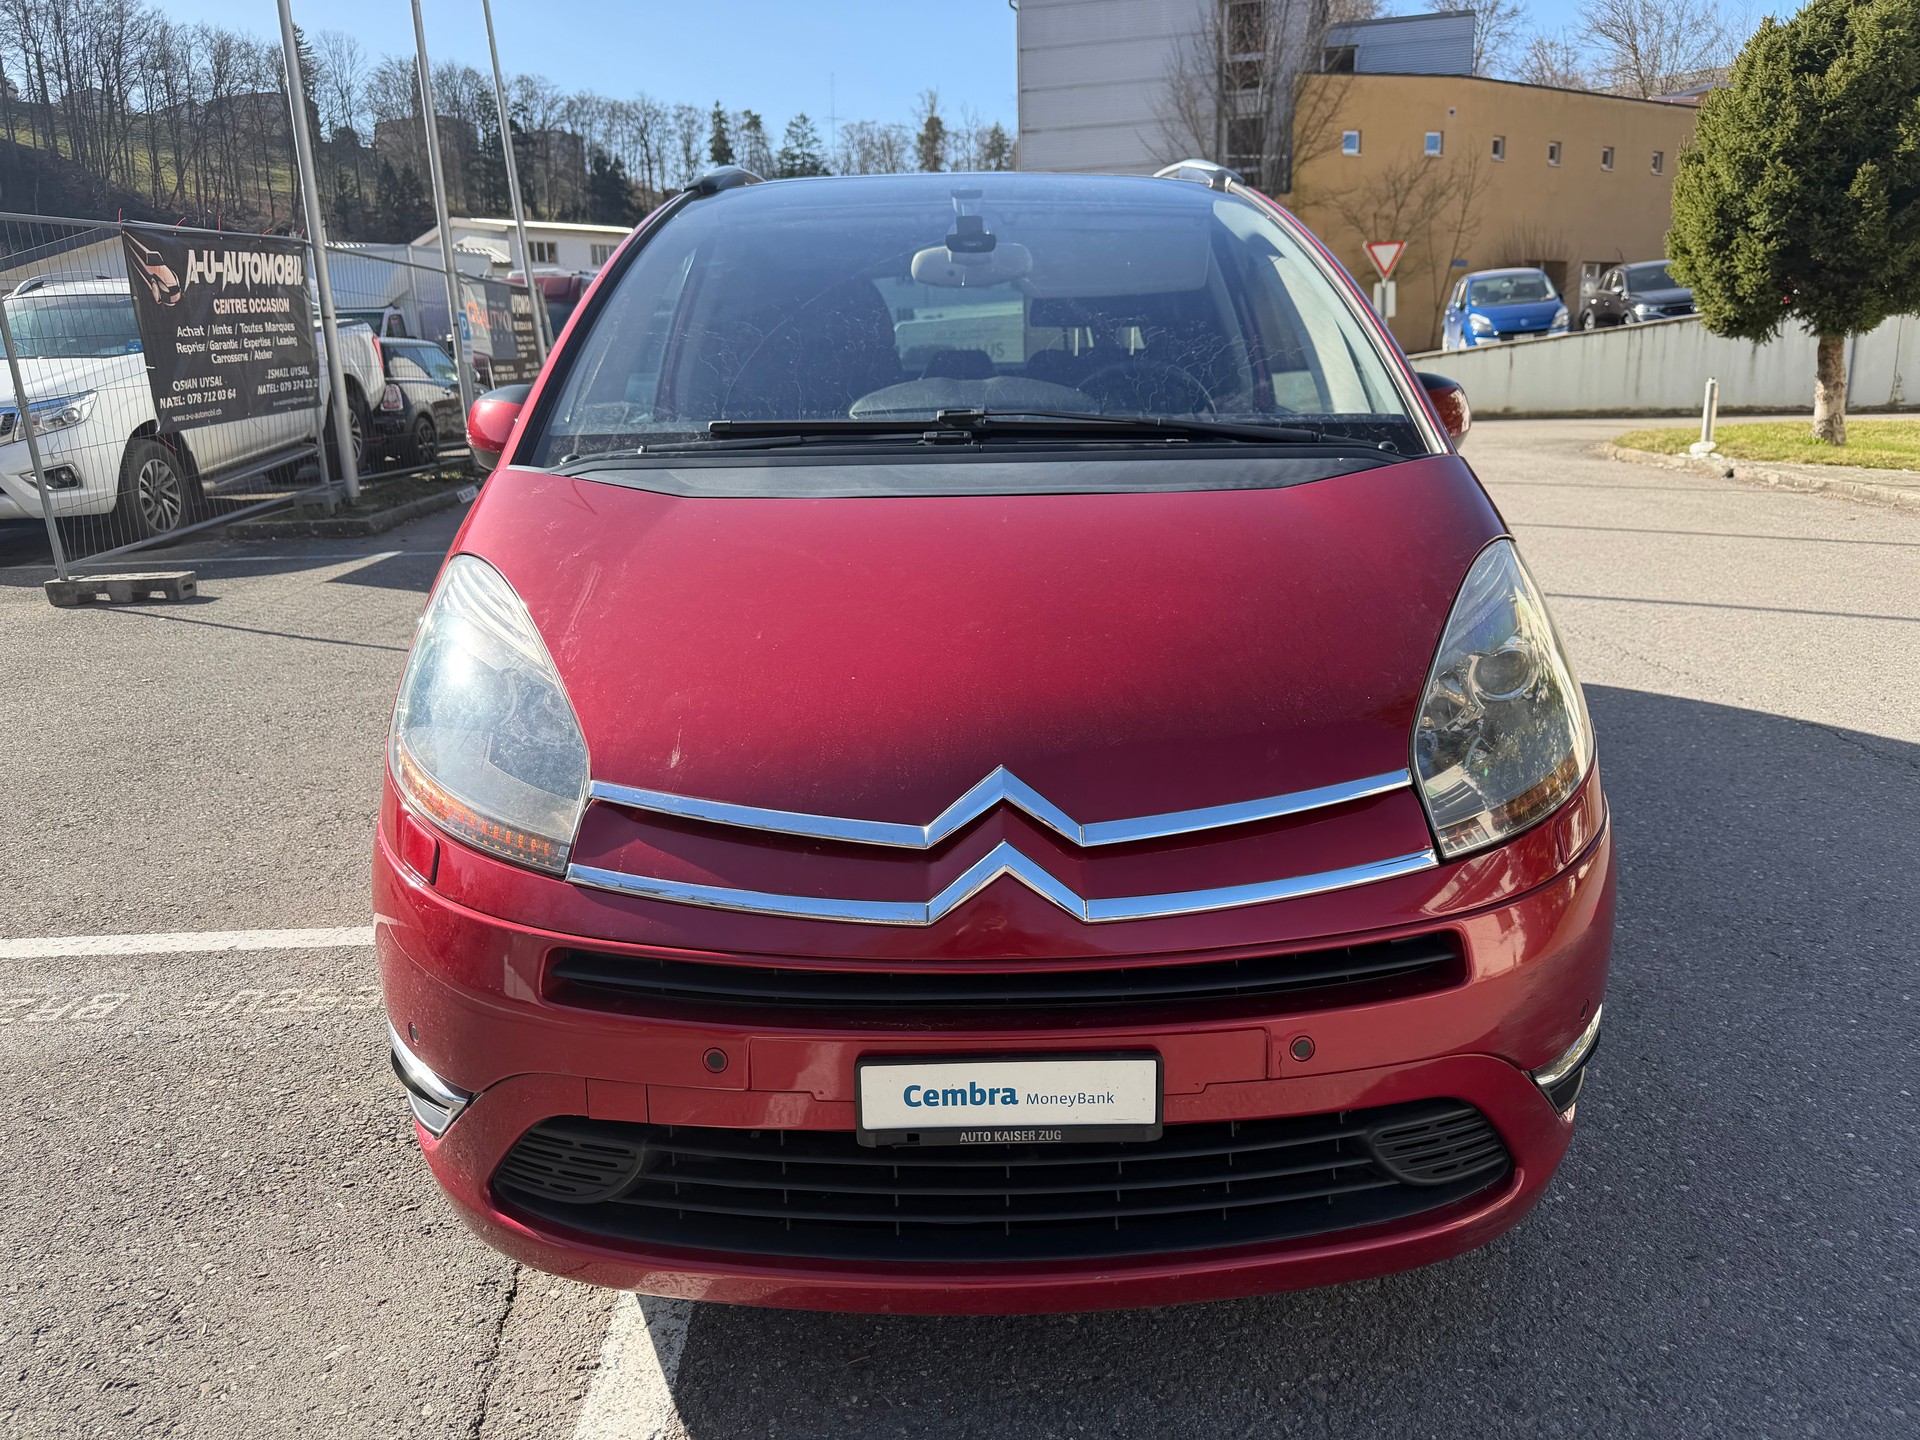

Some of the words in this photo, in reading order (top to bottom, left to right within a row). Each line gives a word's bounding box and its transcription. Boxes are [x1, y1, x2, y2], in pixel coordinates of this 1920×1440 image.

[184, 249, 304, 292] A-U-AUTOMOBIL
[213, 298, 248, 314] CENTRE
[249, 298, 290, 313] OCCASION
[177, 325, 205, 337] Achat
[212, 324, 232, 335] Vente
[239, 322, 264, 334] Toutes
[264, 322, 296, 334] Marques
[176, 342, 205, 355] Reprise
[210, 338, 238, 350] Garantie
[244, 336, 272, 350] Expertise
[276, 335, 298, 346] Leasing
[268, 368, 290, 379] ISMAIL
[290, 366, 310, 376] UYSAL
[200, 376, 223, 388] UYSAL
[258, 384, 279, 395] NATEL:
[280, 381, 292, 392] 079
[293, 380, 304, 390] 374
[305, 378, 313, 388] 22
[160, 396, 186, 409] NATEL:
[187, 392, 202, 404] 078
[204, 390, 216, 402] 712
[218, 389, 226, 400] 03
[228, 388, 236, 399] 64
[903, 1082, 1018, 1108] Cembra
[1026, 1092, 1114, 1108] MoneyBank
[960, 1131, 992, 1142] AUTO
[994, 1130, 1036, 1142] KAISER
[1038, 1130, 1062, 1142] ZUG
